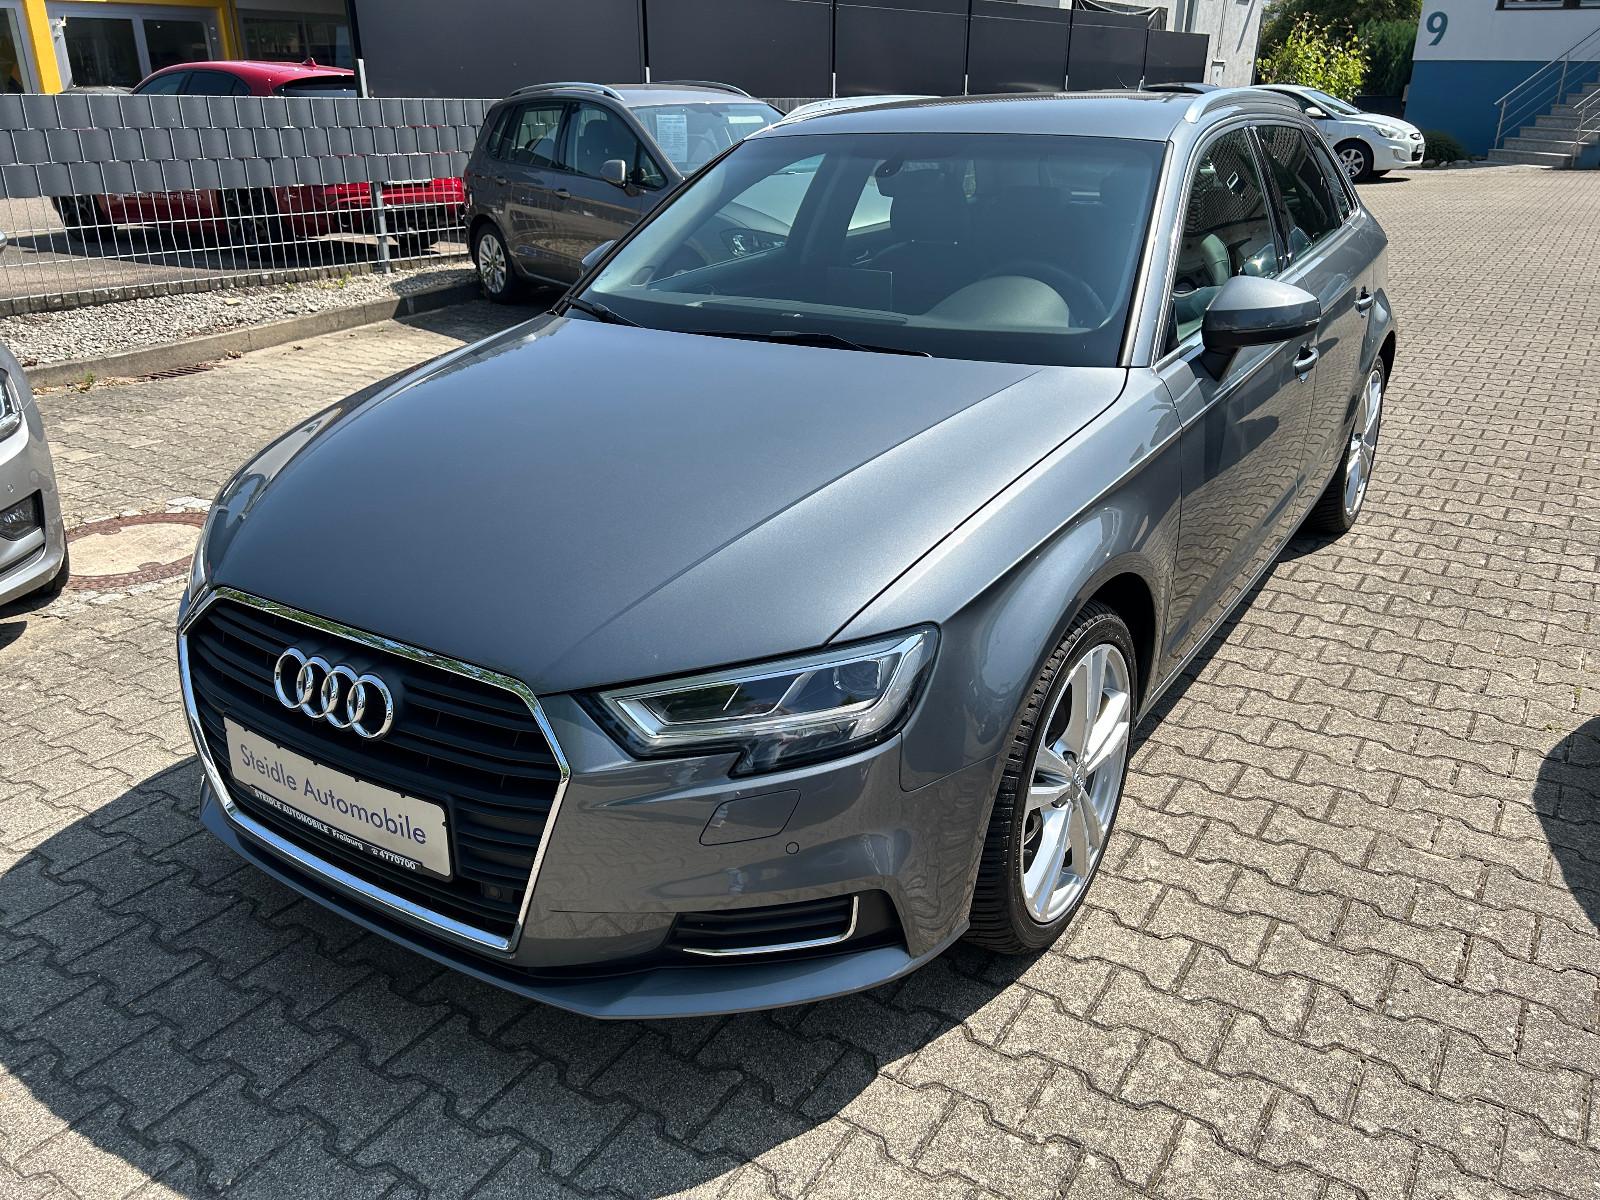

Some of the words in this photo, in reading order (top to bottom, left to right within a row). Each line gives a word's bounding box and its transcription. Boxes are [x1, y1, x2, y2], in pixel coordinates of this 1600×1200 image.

[1426, 11, 1448, 46] 9
[240, 743, 297, 791] Steidle
[303, 777, 426, 844] Automobile
[254, 788, 282, 810] STEIDLE
[282, 804, 330, 835] AUTOMOBILE
[331, 828, 364, 851] Freiburg
